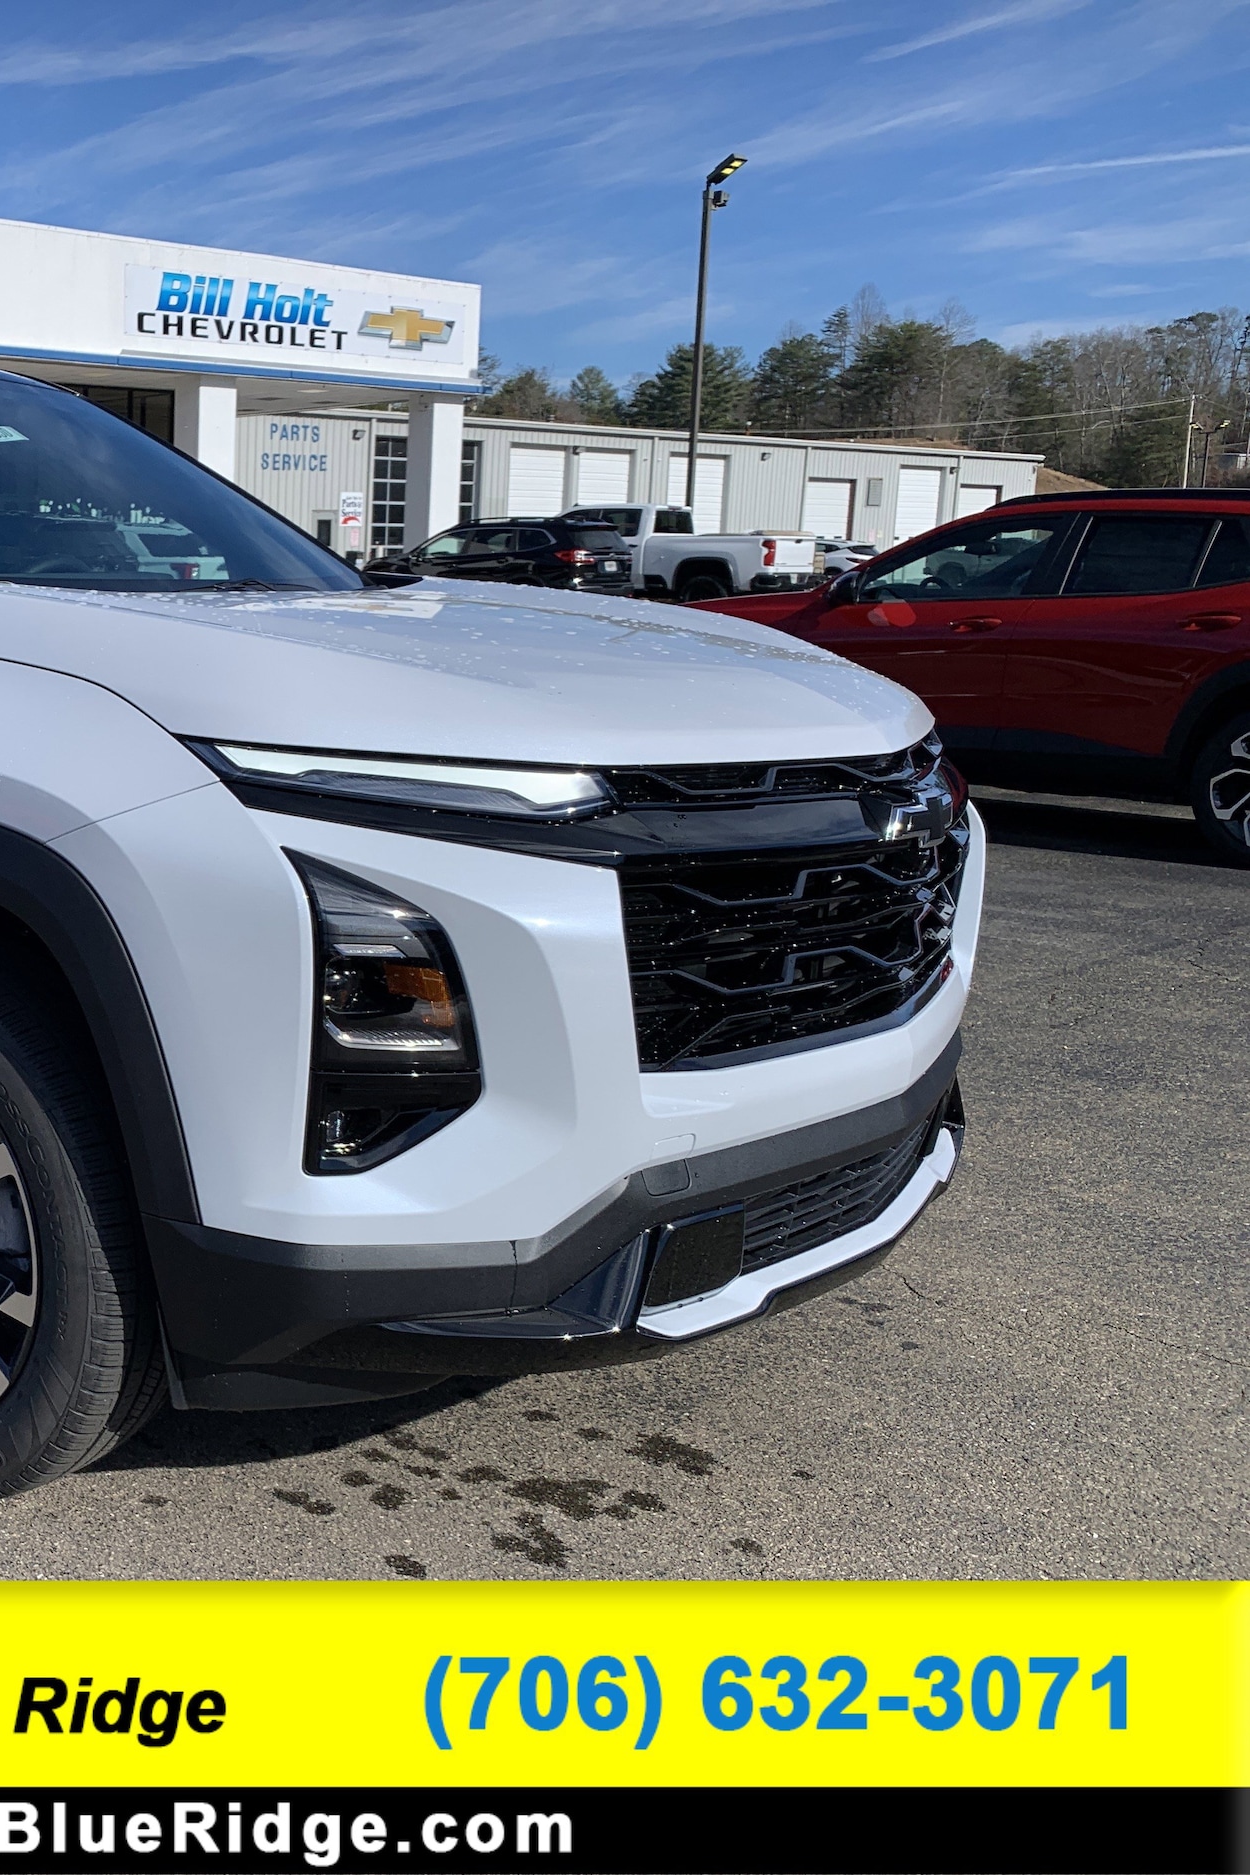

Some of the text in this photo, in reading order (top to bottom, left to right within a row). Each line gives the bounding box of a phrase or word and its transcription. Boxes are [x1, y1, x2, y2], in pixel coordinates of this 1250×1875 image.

[156, 271, 334, 327] Bill Holt
[137, 311, 348, 350] CHEVROLET
[269, 423, 321, 443] PARTS
[260, 453, 328, 472] SERVICE
